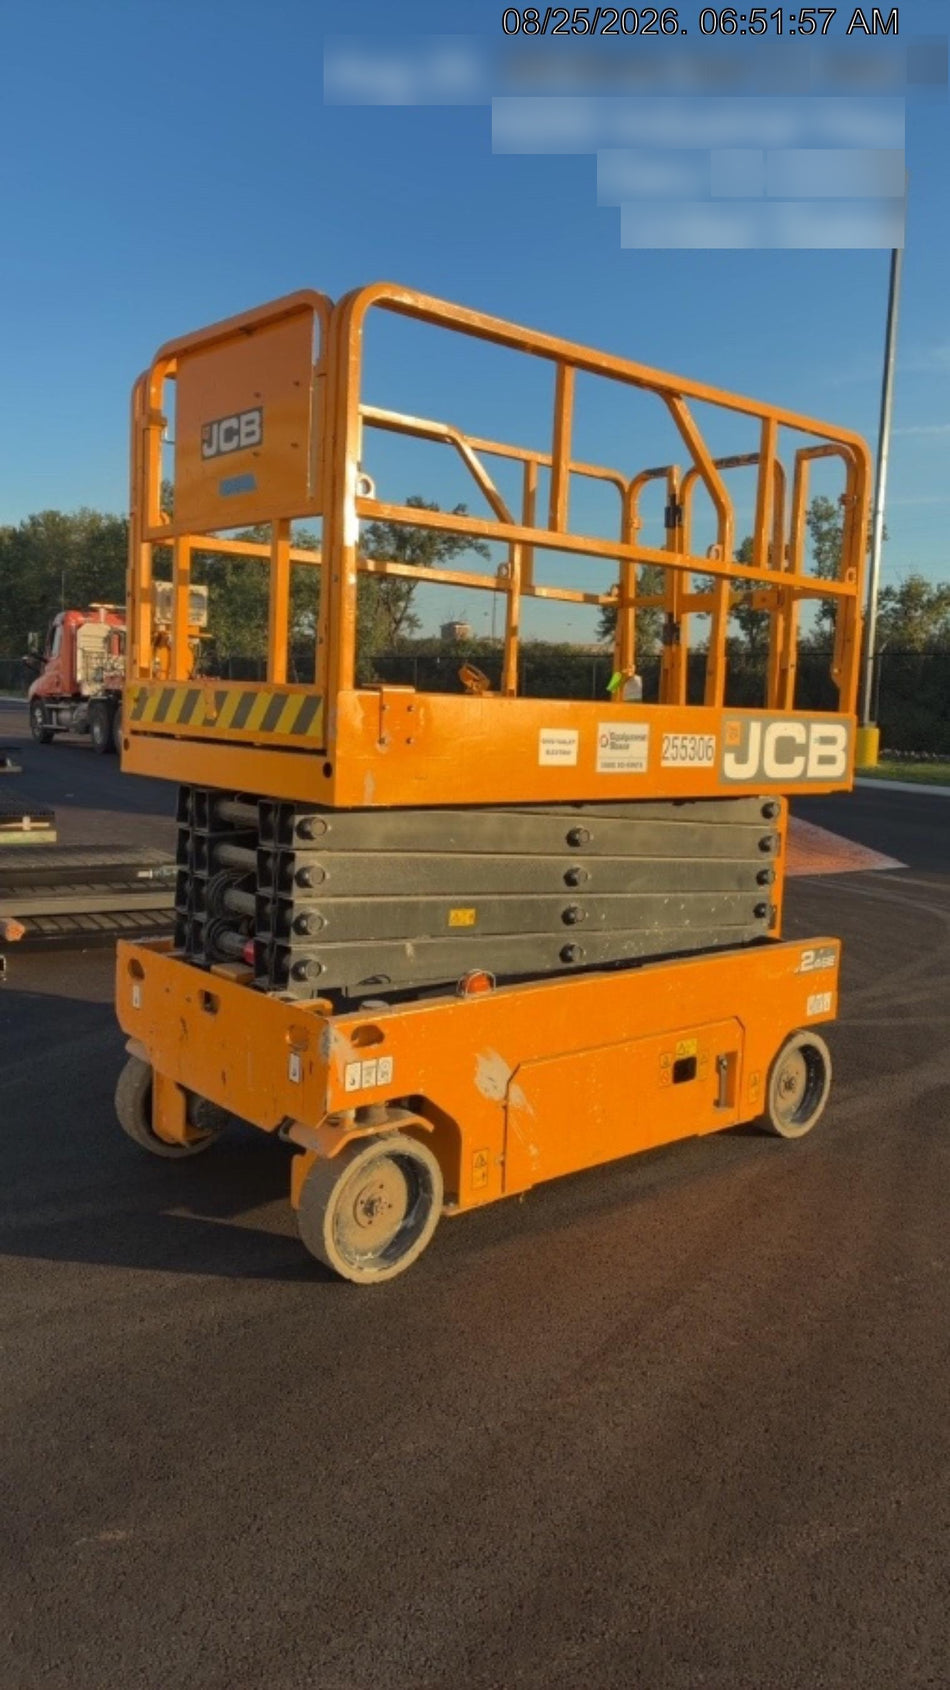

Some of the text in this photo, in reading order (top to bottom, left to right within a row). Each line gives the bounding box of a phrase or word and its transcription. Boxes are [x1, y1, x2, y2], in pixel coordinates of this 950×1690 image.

[202, 410, 262, 458] JCB
[661, 735, 715, 762] 255306
[723, 720, 847, 780] JCB
